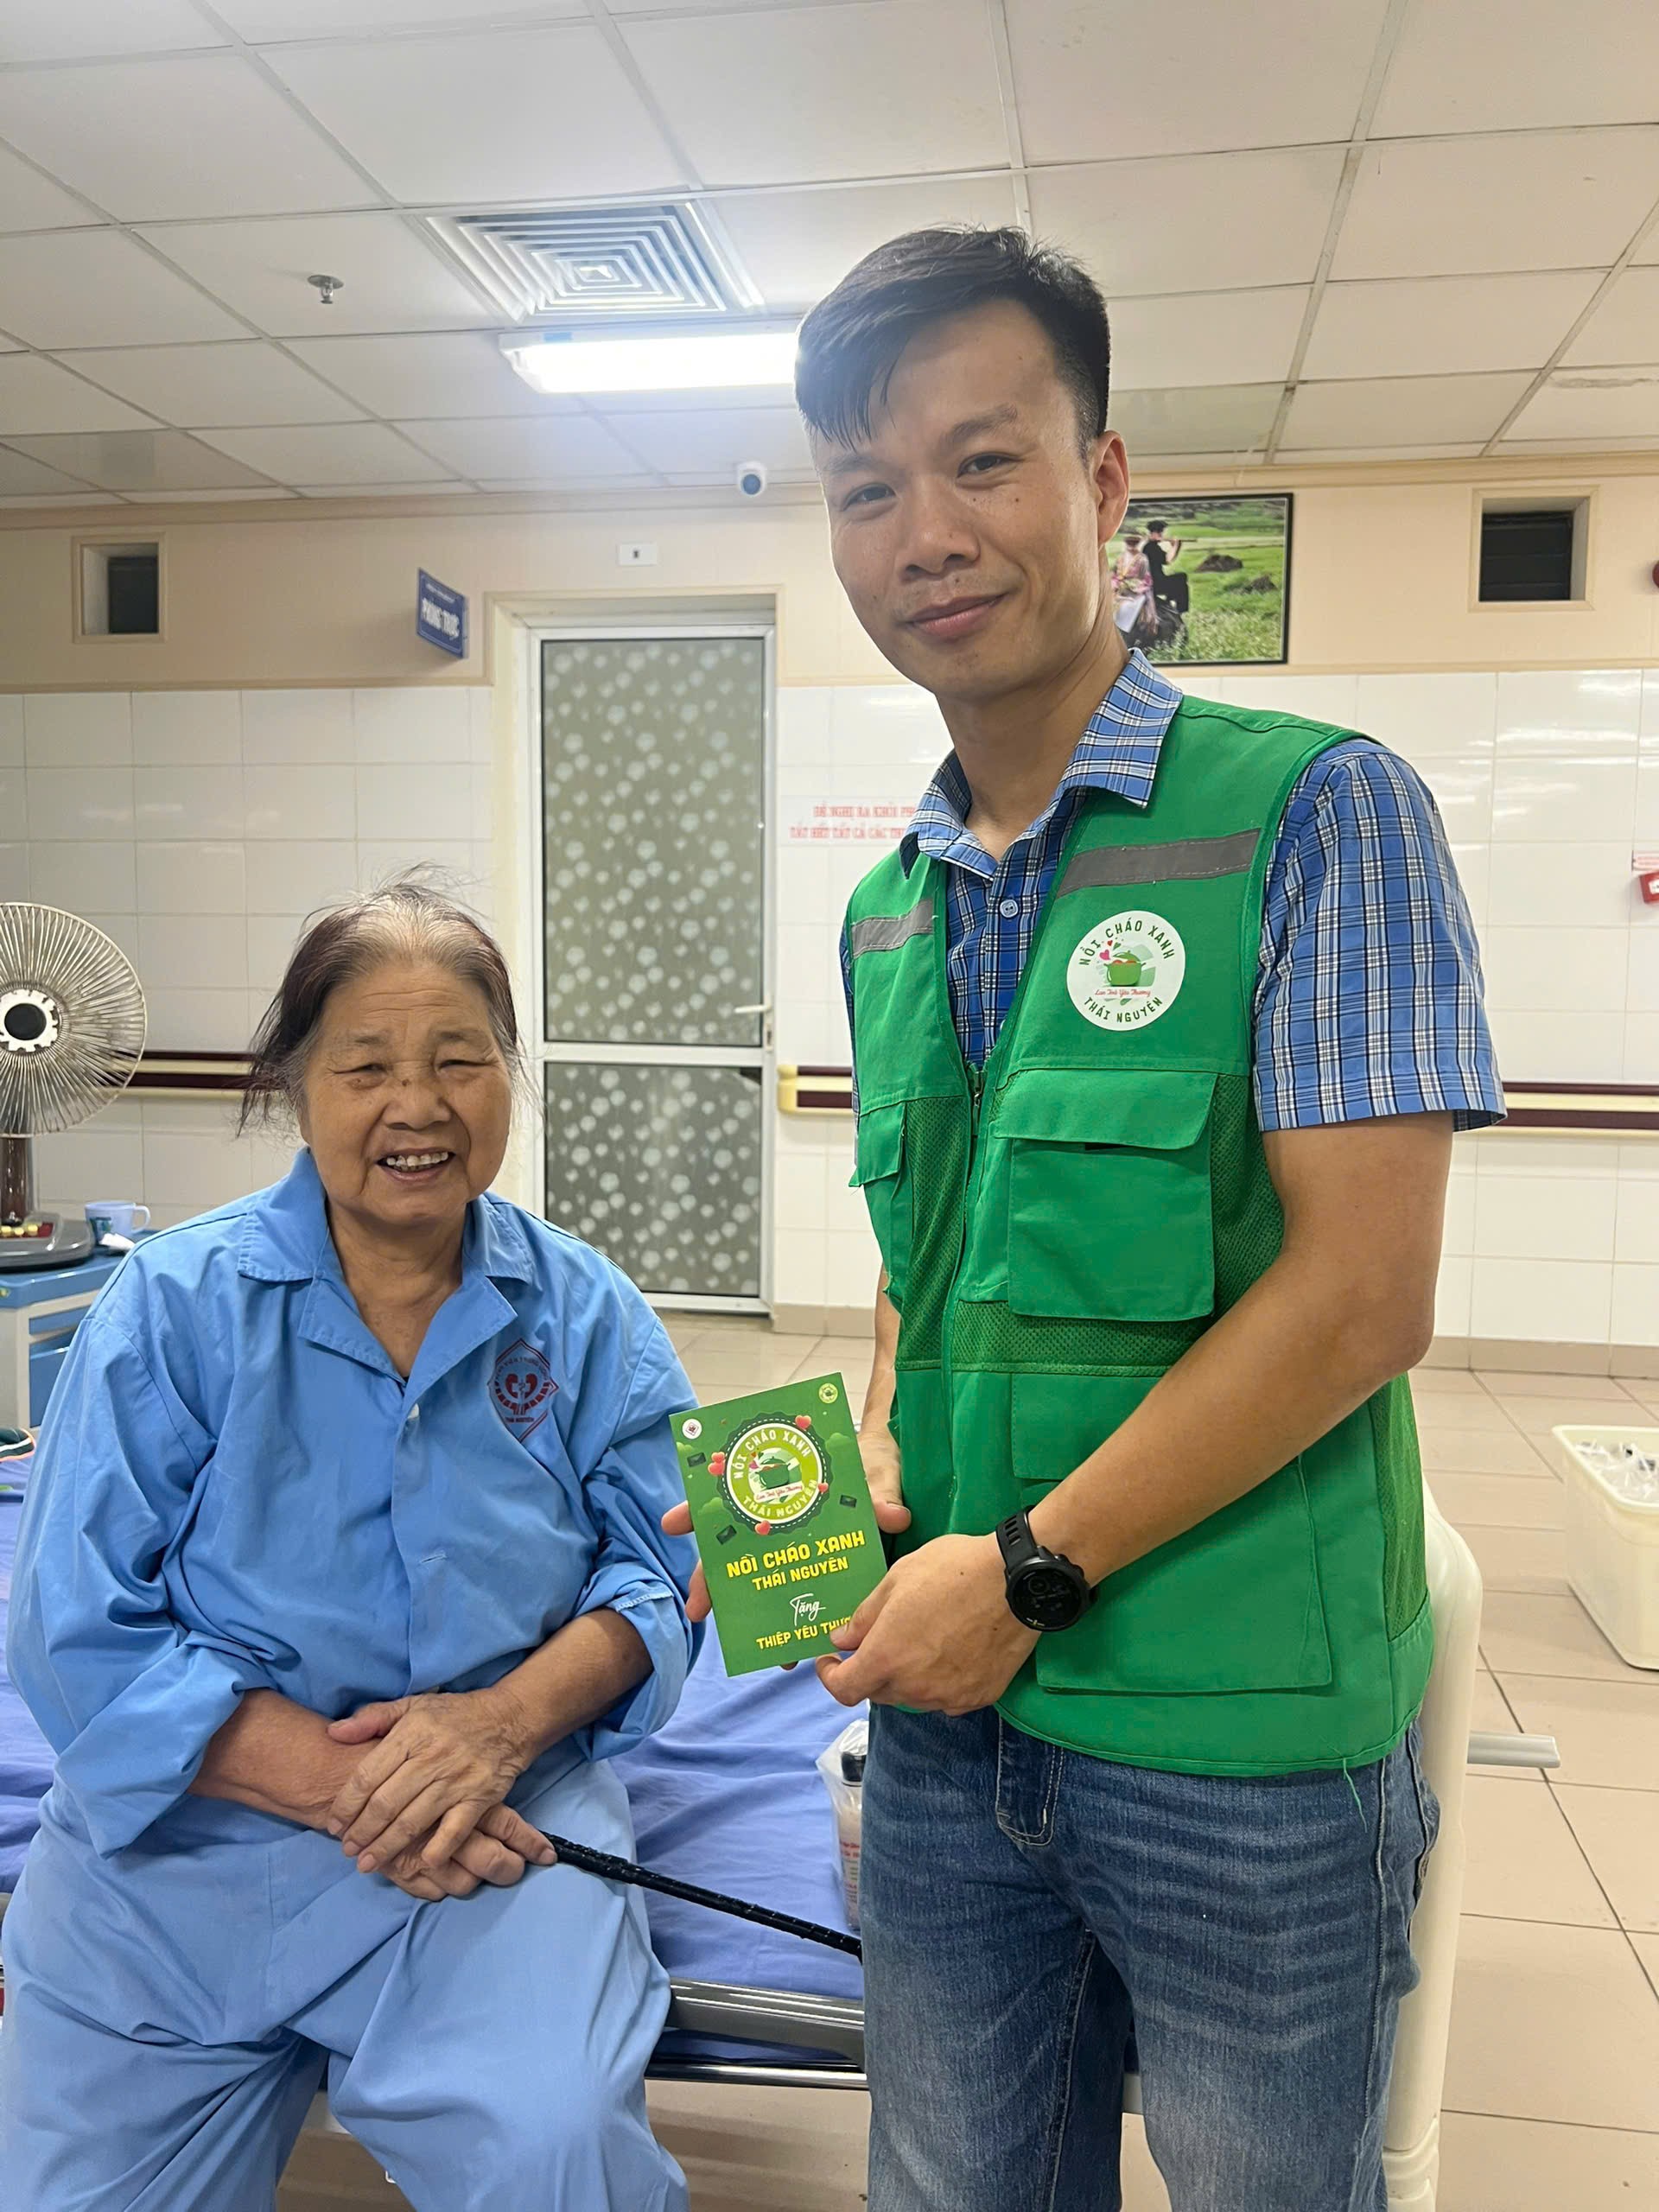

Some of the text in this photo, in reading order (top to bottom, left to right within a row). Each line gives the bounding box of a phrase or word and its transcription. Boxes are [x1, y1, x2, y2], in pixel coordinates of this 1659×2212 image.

[1079, 917, 1175, 966] NỒI CHÁO XANH
[1084, 996, 1163, 1023] THÁI NGUYÊN
[731, 1429, 811, 1479] NỒI CHÁO XANH
[743, 1496, 772, 1517] THÁI
[777, 1479, 817, 1517] NGUYÊN
[727, 1530, 866, 1578] NỒI CHÁO XANH
[752, 1556, 849, 1591] THÁI NGUYÊN
[789, 1592, 827, 1626] Tặng
[756, 1630, 791, 1649] THIỆP
[794, 1624, 818, 1641] YÊU
